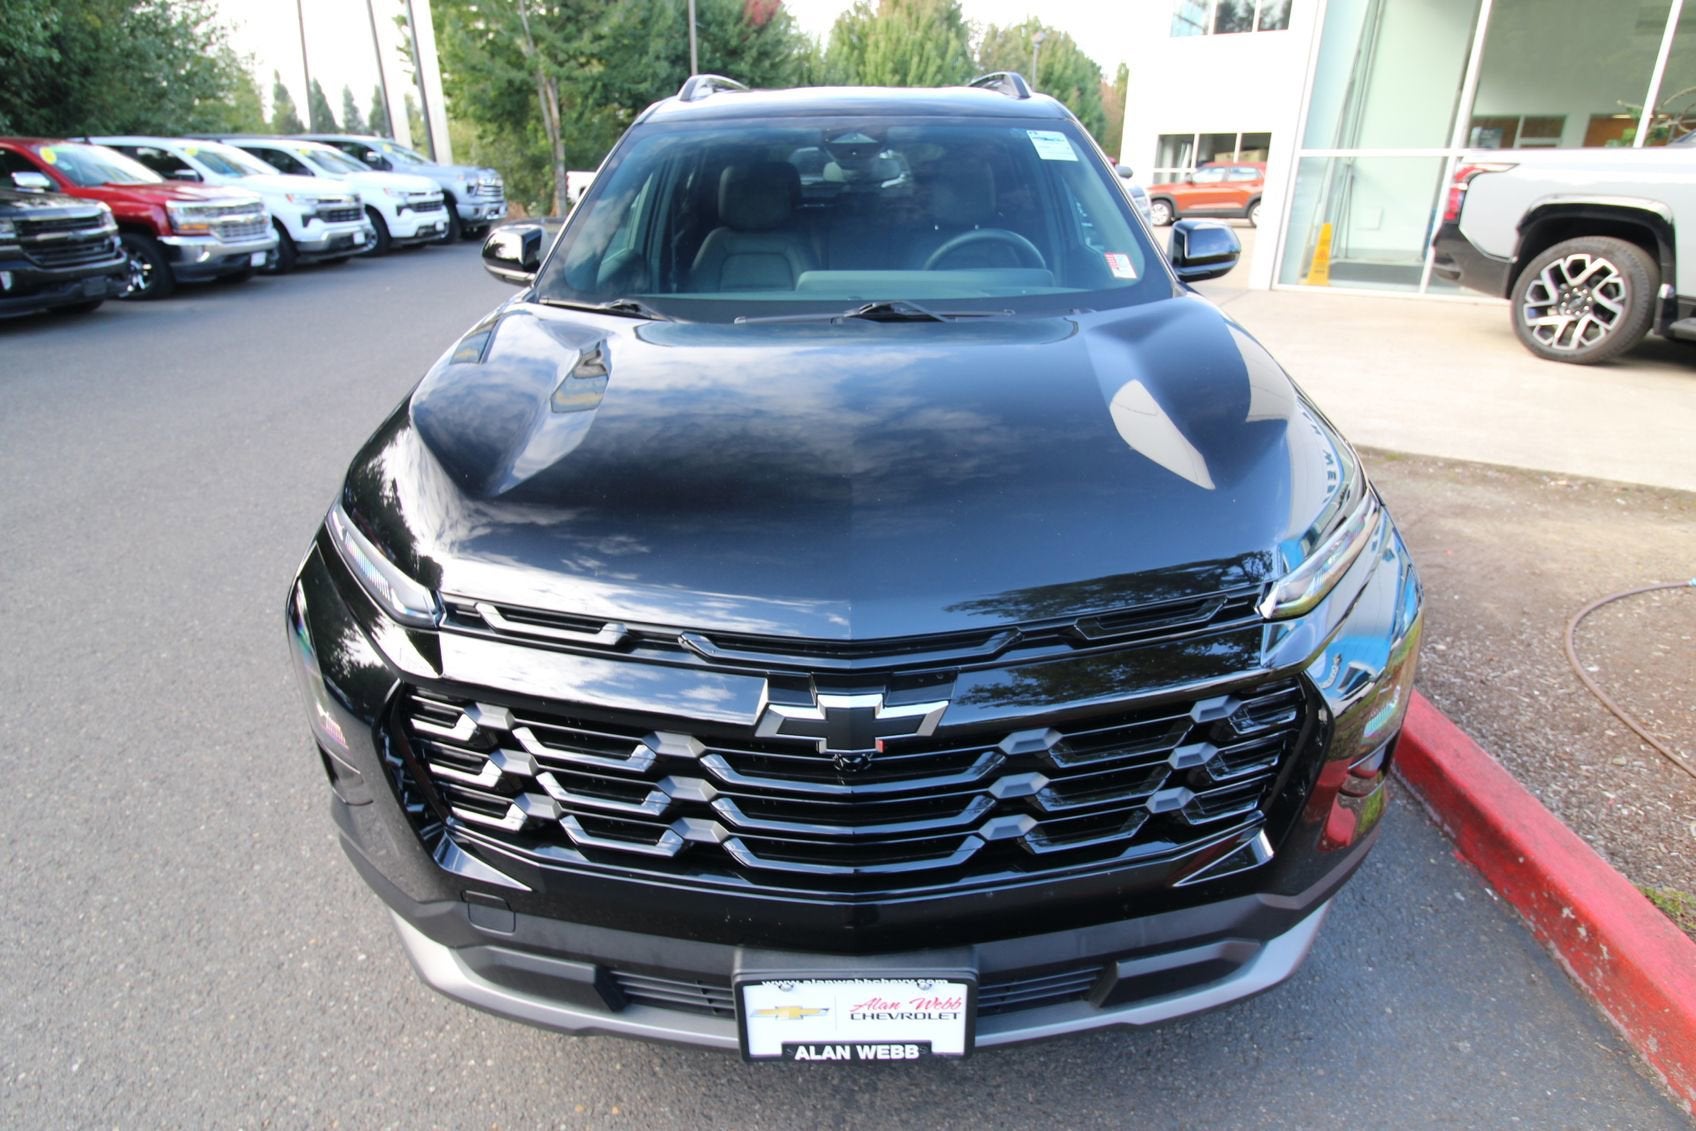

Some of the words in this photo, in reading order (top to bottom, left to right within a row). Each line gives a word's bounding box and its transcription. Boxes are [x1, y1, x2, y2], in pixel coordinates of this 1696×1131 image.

[849, 997, 901, 1012] Alan
[908, 996, 963, 1010] Webb
[850, 1012, 960, 1021] CHEVROLET
[794, 1044, 851, 1060] ALAN
[856, 1043, 920, 1060] WEBB
